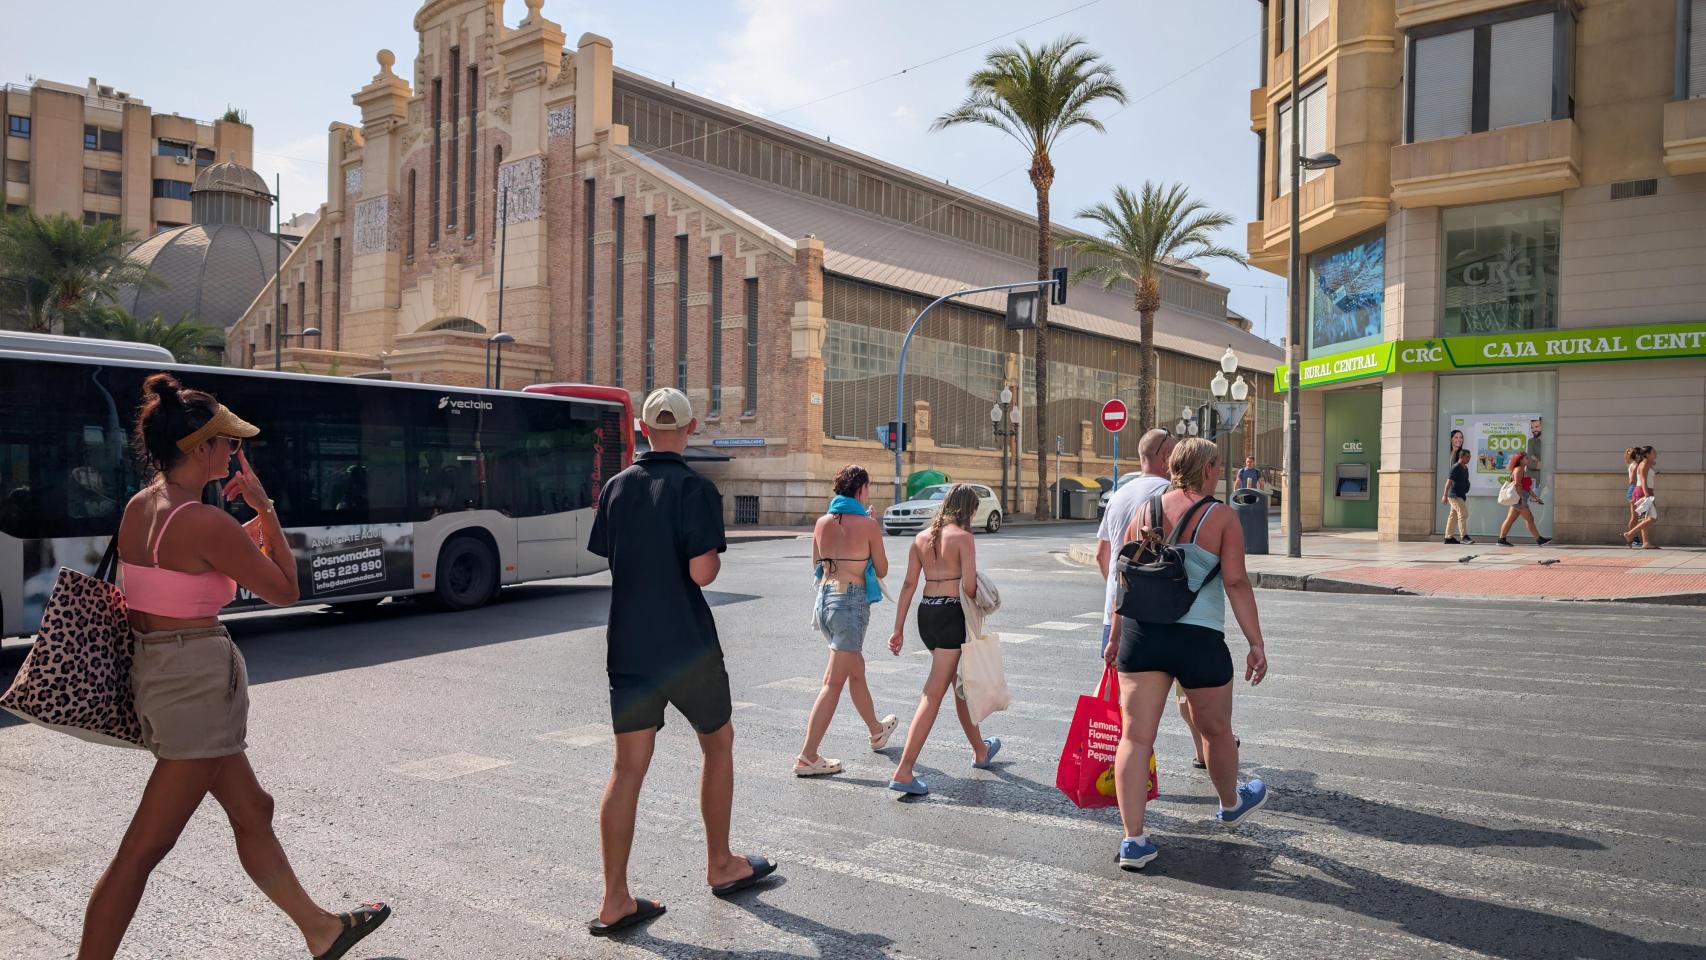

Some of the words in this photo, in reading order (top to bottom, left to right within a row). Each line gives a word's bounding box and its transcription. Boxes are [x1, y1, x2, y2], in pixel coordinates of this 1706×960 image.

[1463, 258, 1532, 286] CRC
[1483, 341, 1539, 358] CAJA
[1545, 336, 1628, 356] RURAL
[1635, 331, 1706, 350] CENT
[1402, 347, 1442, 363] CRC
[1304, 362, 1332, 380] RURAL
[1333, 353, 1378, 374] CENTRAL
[450, 400, 493, 410] vectalia
[1343, 442, 1362, 450] CRC
[313, 548, 381, 567] dosnomadas
[313, 568, 336, 581] 965
[338, 563, 359, 577] 229
[360, 559, 382, 572] 890
[1089, 718, 1121, 734] Lemons,
[1088, 729, 1120, 743] Flowers,
